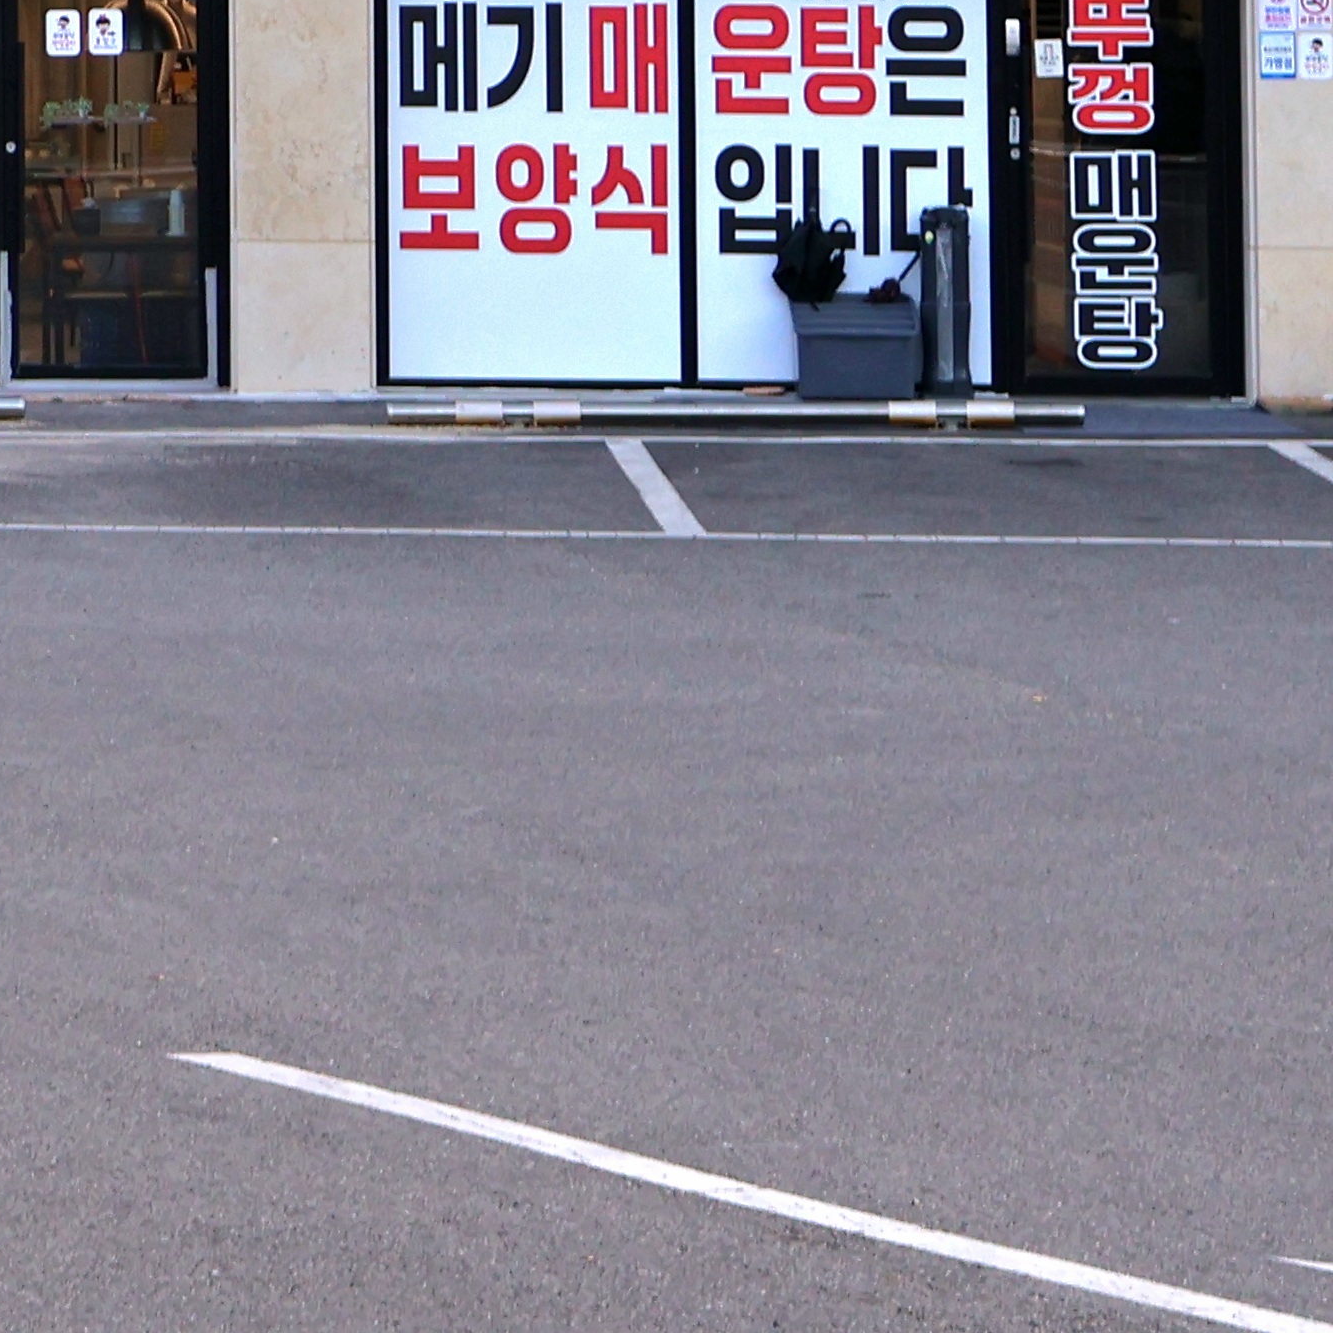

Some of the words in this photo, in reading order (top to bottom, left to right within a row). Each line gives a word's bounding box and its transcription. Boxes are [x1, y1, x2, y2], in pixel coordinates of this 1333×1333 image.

[399, 2, 563, 113] 메기
[399, 144, 668, 255] 보양식
[1070, 150, 1163, 370] 매운탕
